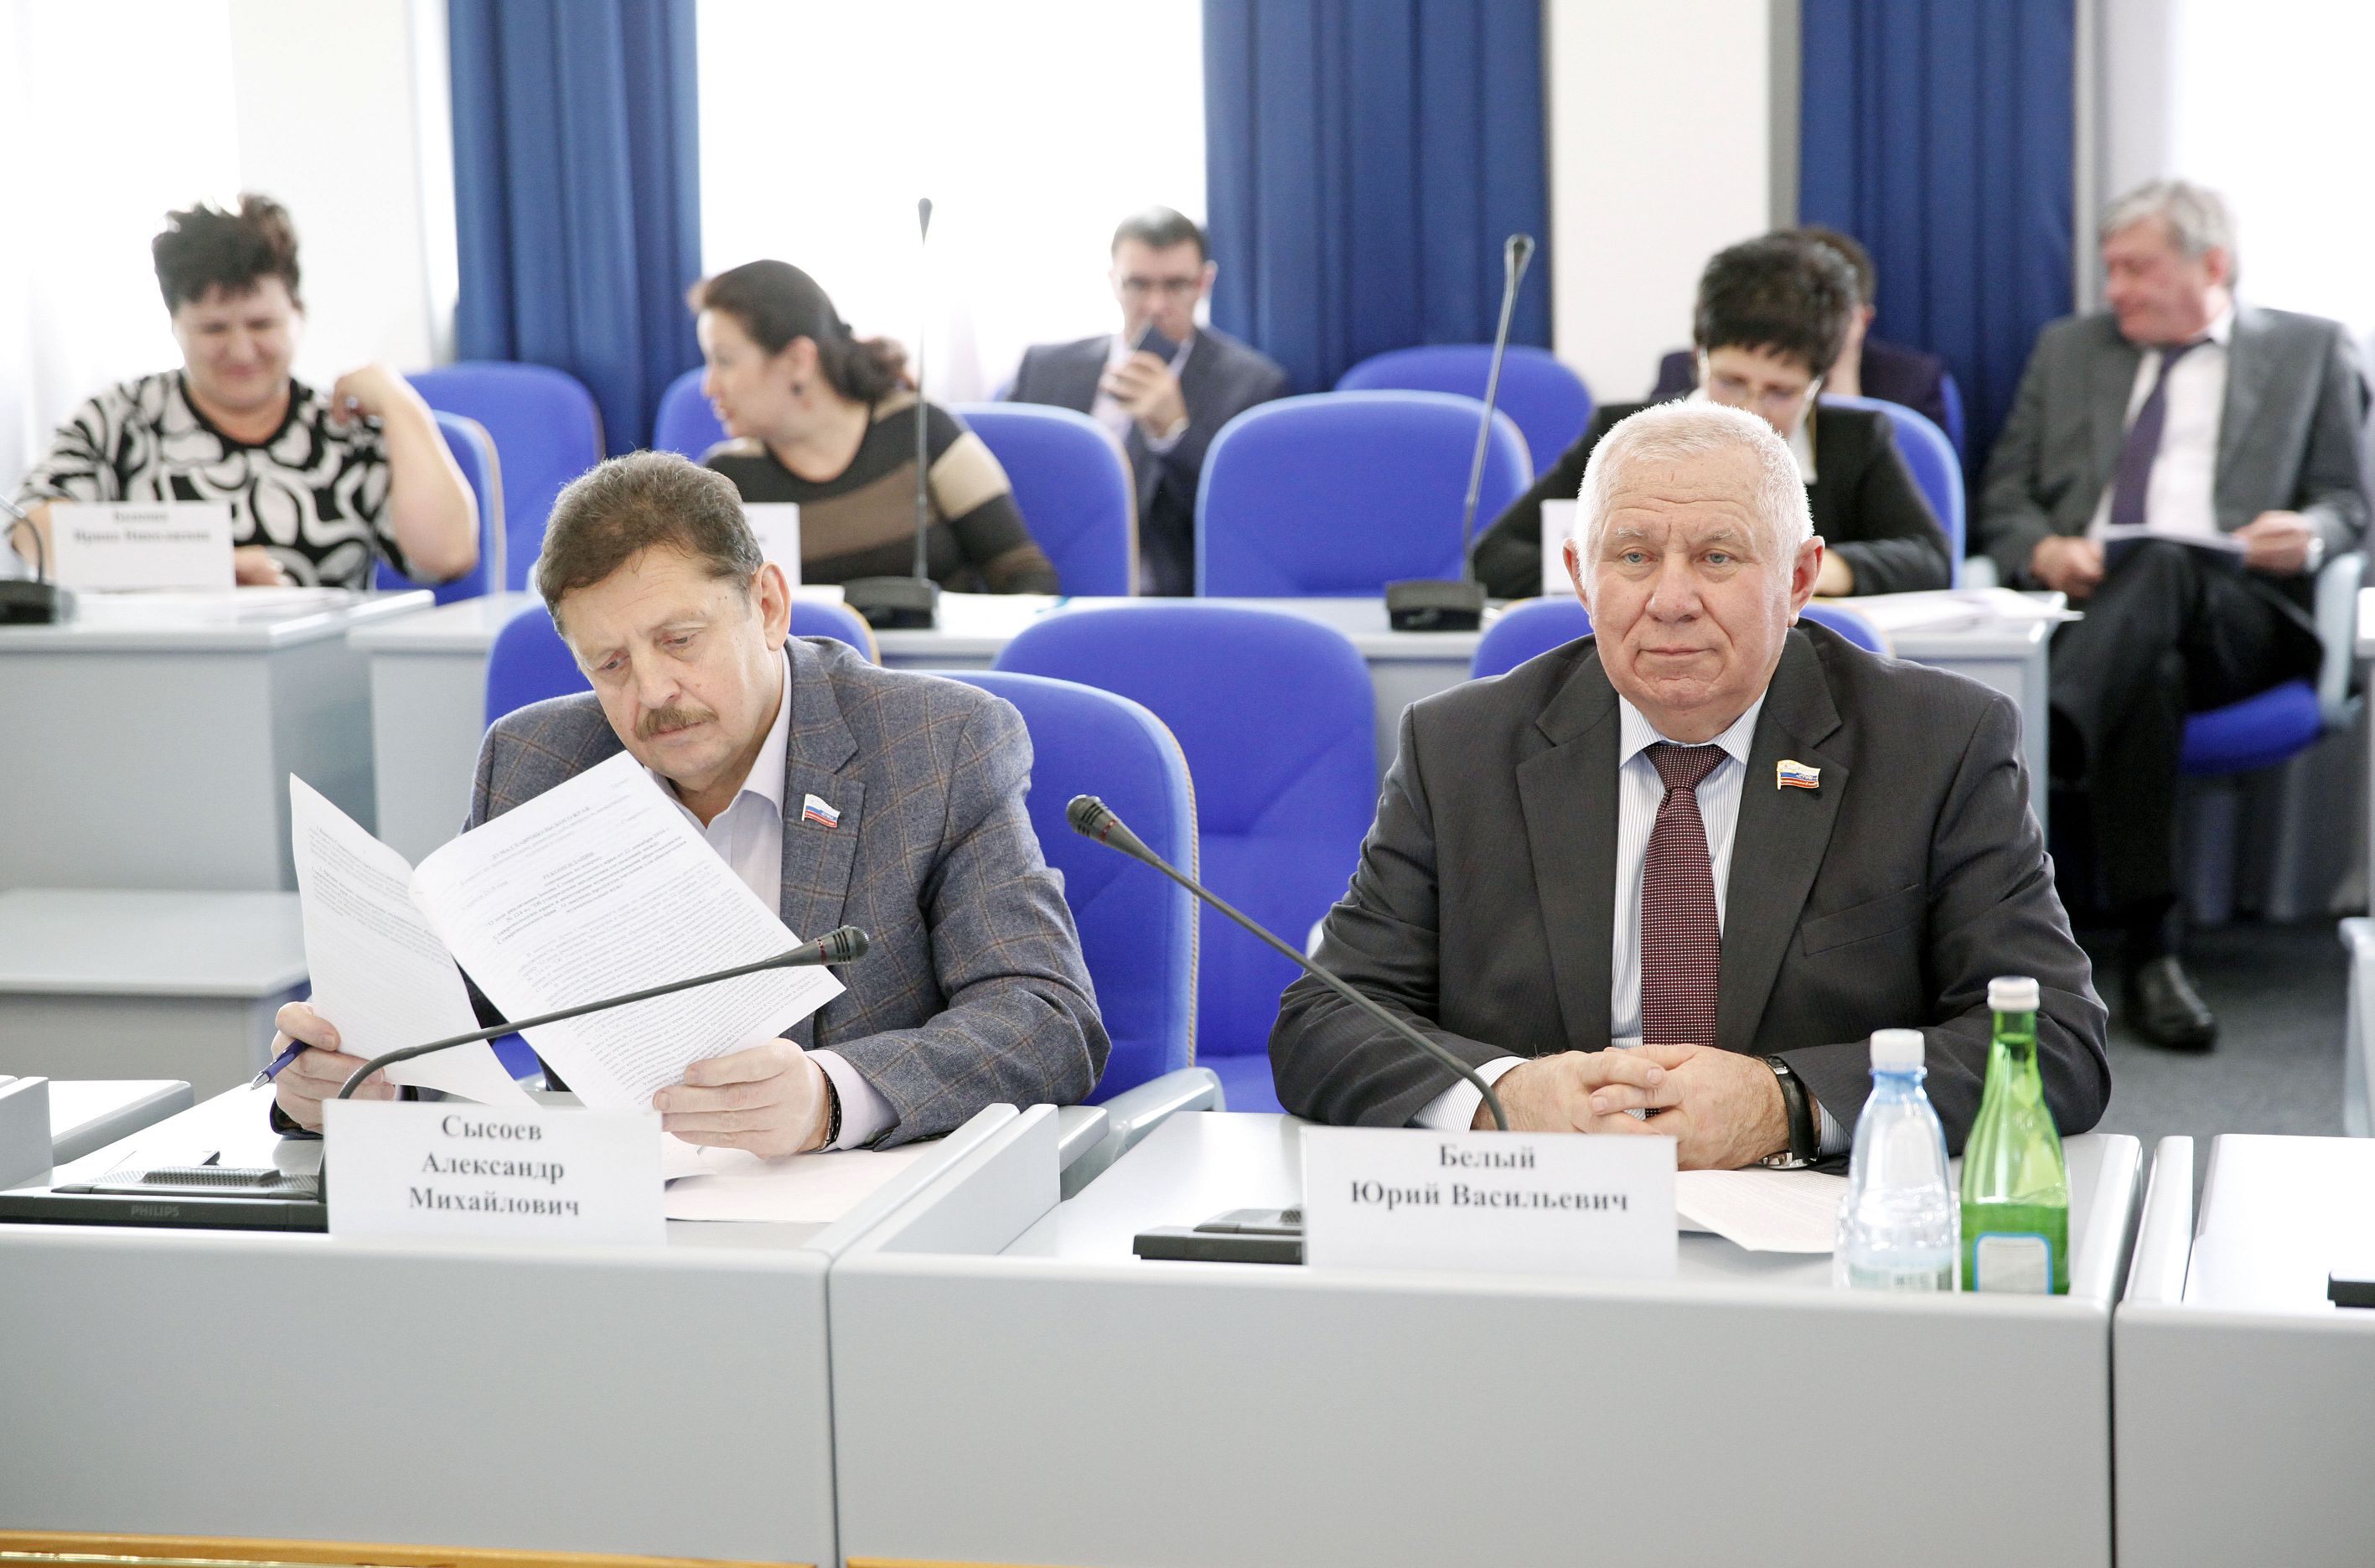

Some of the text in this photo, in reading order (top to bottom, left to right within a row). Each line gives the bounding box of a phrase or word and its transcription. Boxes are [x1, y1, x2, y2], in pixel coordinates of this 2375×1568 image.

[441, 1115, 542, 1141] Сысоев
[422, 1152, 565, 1185] Александр
[1440, 1144, 1535, 1169] Белый
[410, 1186, 579, 1216] Михайлович
[1351, 1180, 1628, 1212] Юрий Васильевич
[131, 1205, 179, 1217] PHILIPS
